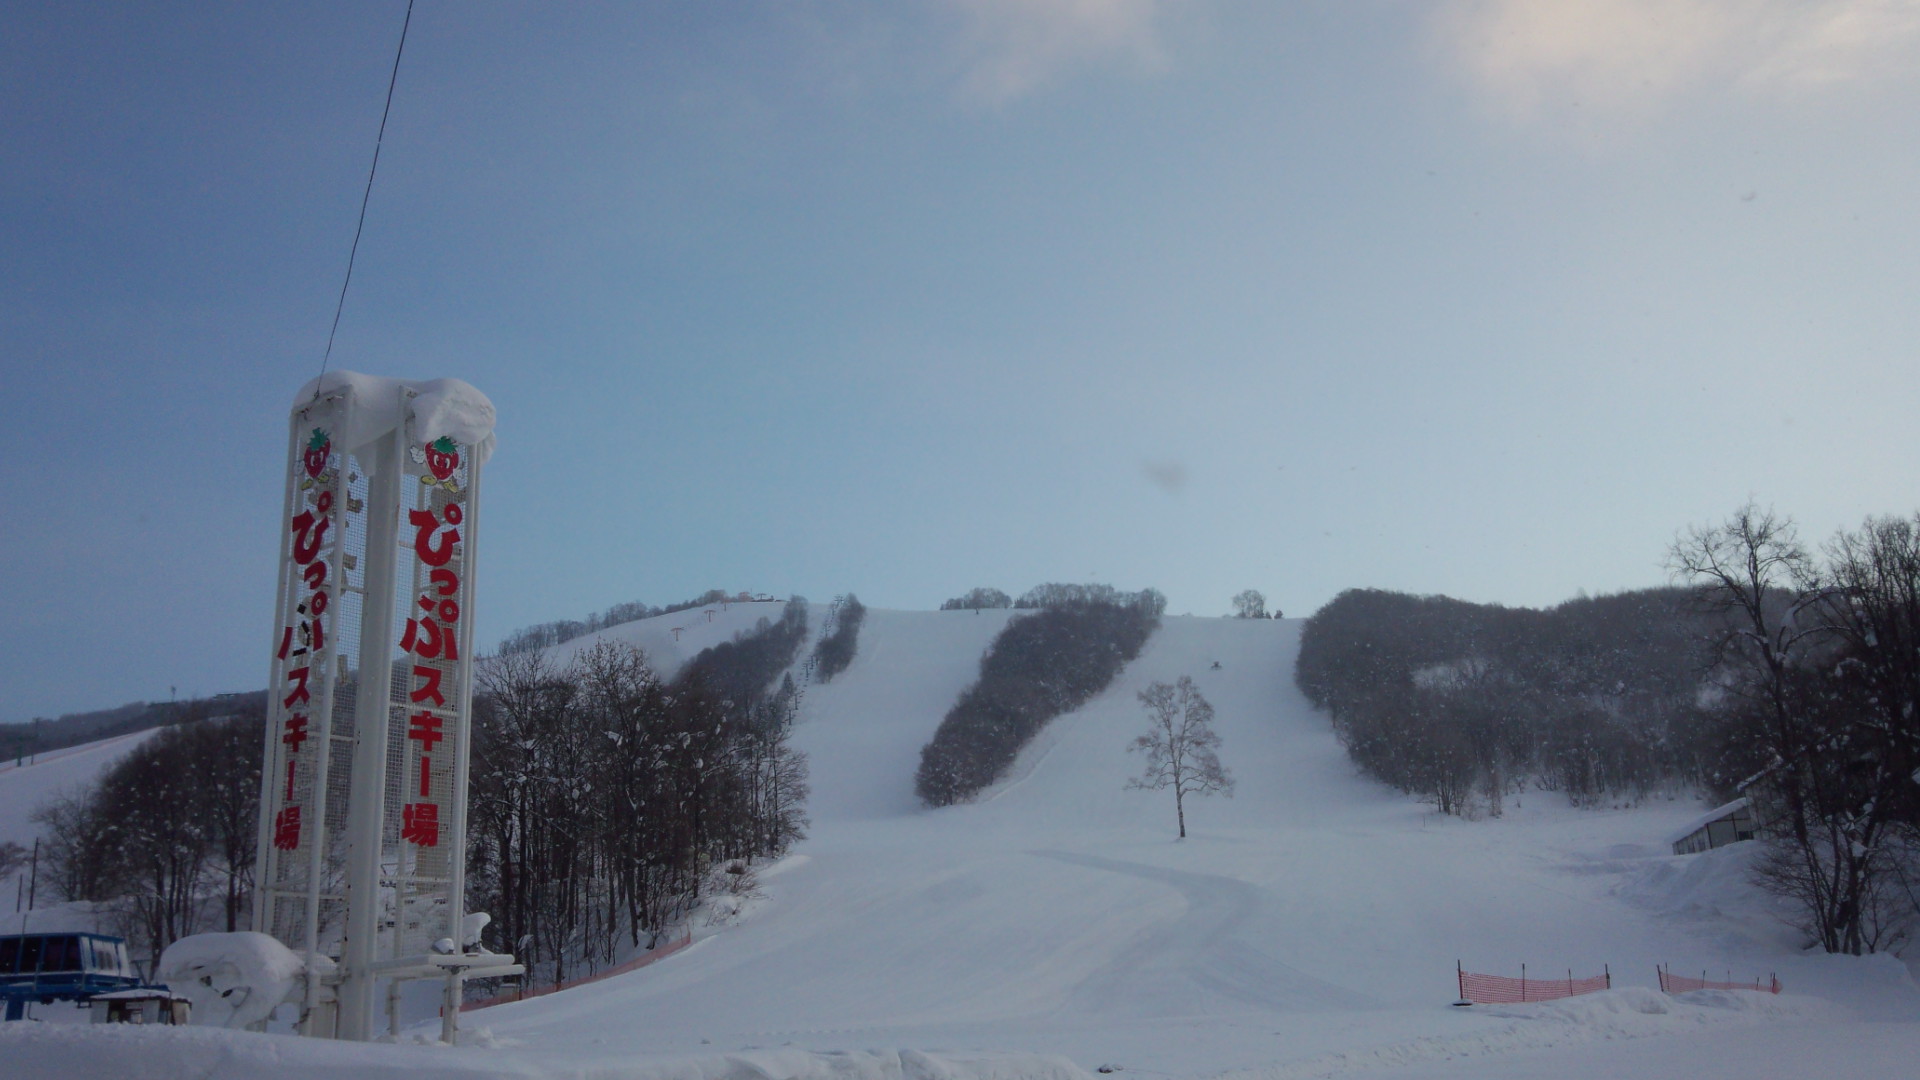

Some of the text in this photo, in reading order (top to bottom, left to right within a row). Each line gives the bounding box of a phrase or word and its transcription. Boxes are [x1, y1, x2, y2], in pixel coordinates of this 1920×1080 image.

[399, 503, 463, 847] ぴっぷスキー場
